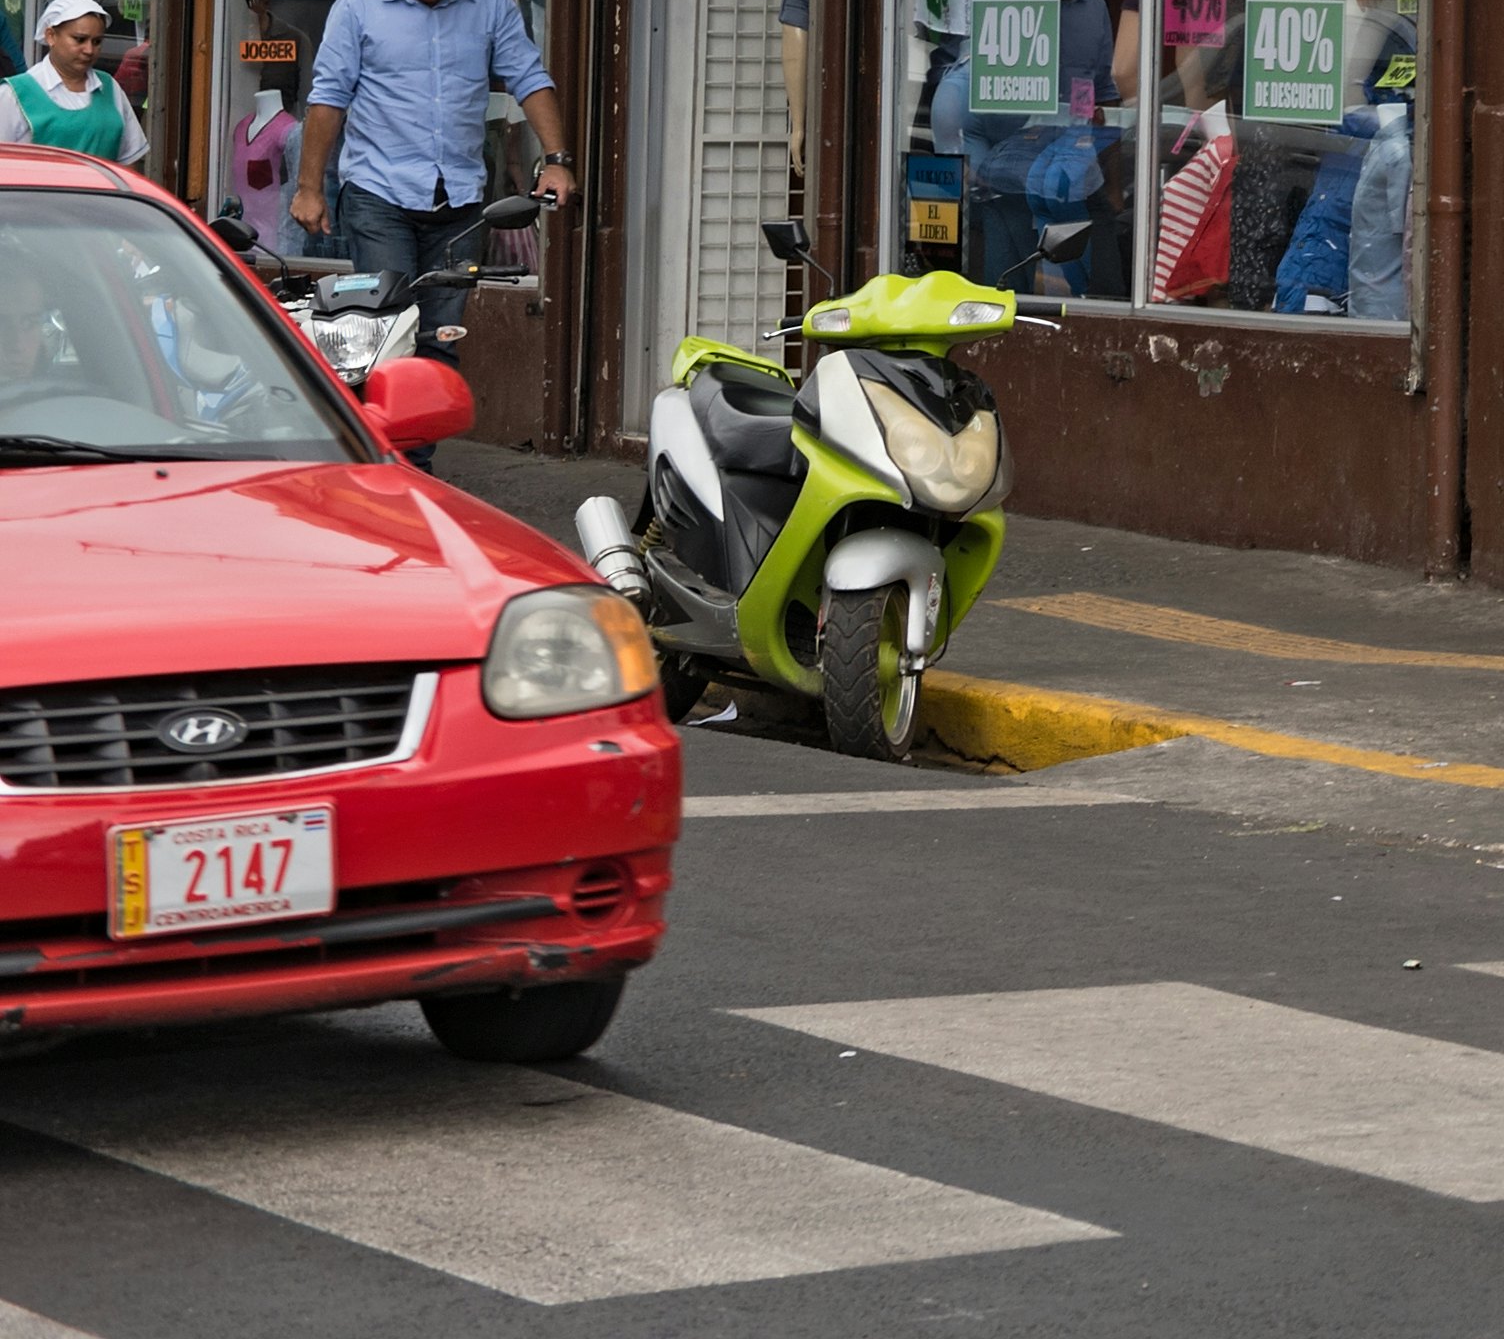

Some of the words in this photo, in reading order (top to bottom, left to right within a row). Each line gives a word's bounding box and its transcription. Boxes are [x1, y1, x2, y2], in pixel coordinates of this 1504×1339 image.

[978, 5, 1051, 67] 40%
[1254, 6, 1335, 74] 40%
[241, 42, 294, 60] JOGGER
[978, 76, 993, 102] DE
[993, 75, 1050, 102] DESCUENTO
[1254, 81, 1269, 108] DE
[1270, 81, 1335, 111] DESCUENTO
[928, 204, 941, 220] EL
[919, 223, 949, 241] LIDER
[172, 828, 227, 845] COSTA
[234, 823, 272, 838] RICA
[183, 838, 295, 905] 2147
[155, 899, 292, 927] CENTROAMERICA
